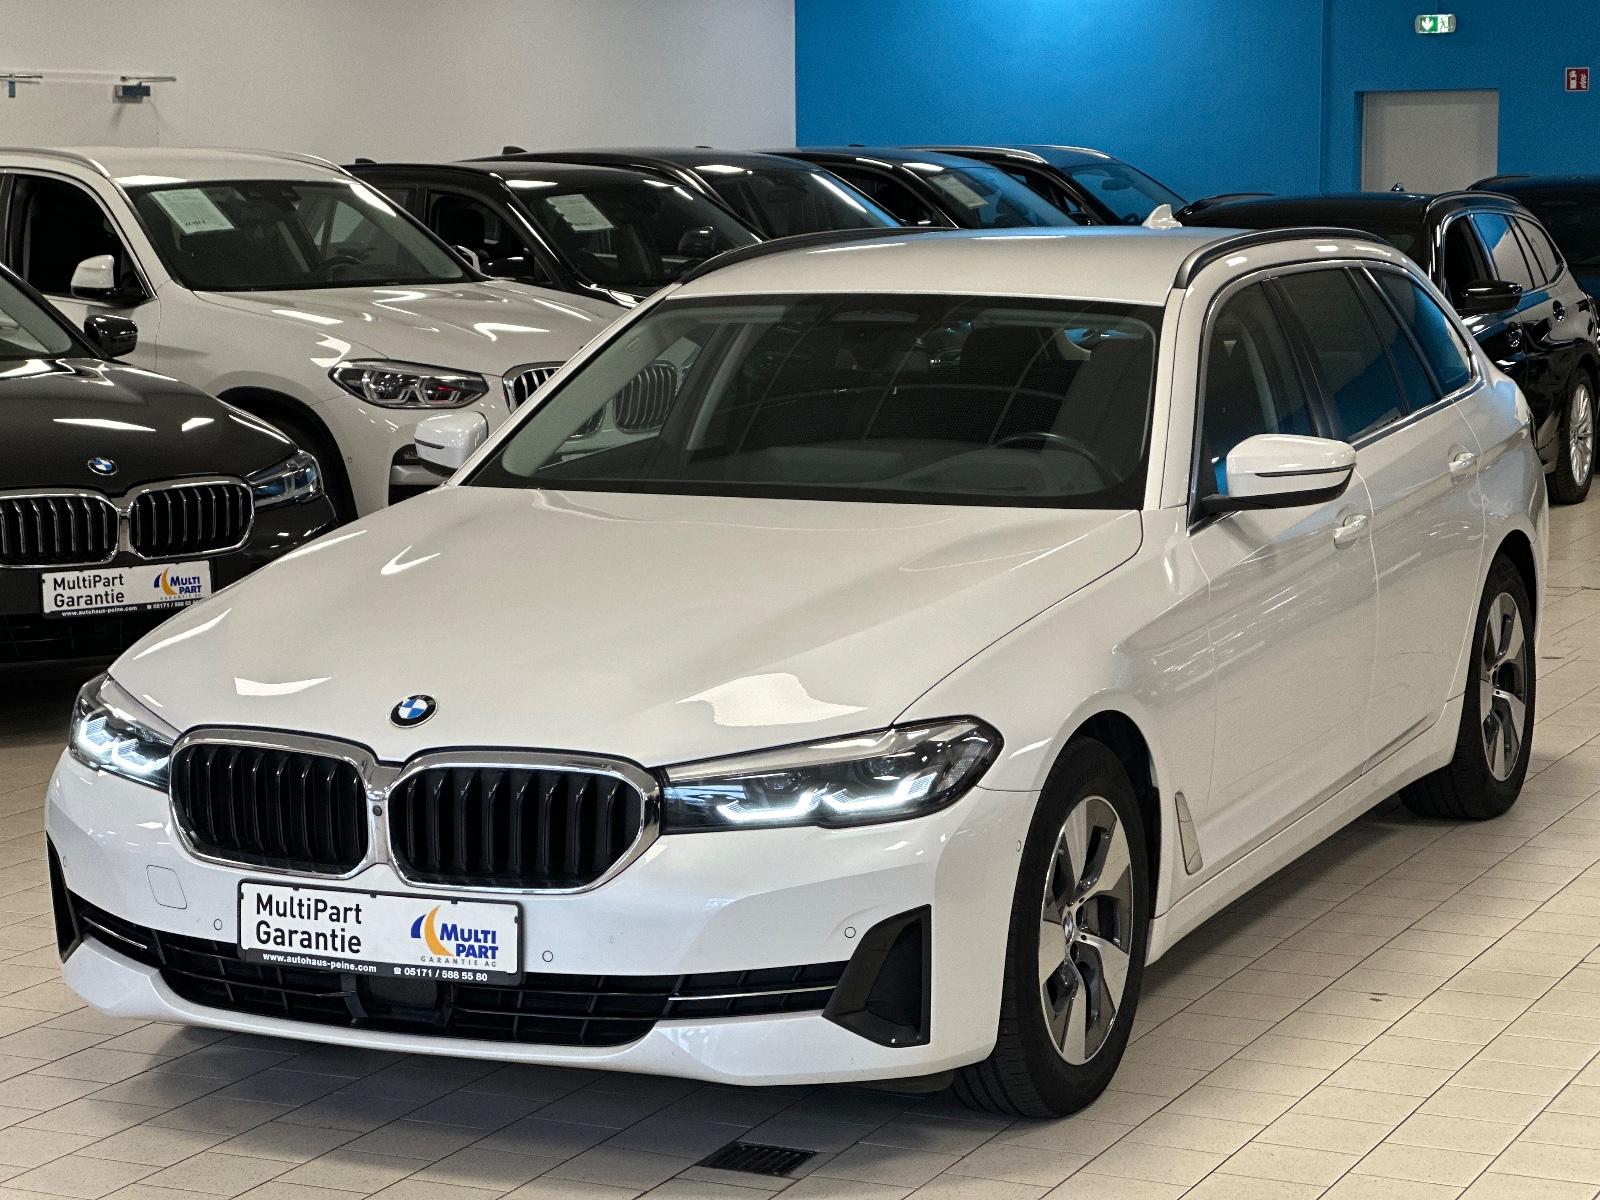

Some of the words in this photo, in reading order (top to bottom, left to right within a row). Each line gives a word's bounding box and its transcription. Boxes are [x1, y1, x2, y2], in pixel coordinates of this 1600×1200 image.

[53, 573, 125, 591] MultiPart
[170, 576, 200, 586] MULTI
[179, 585, 202, 594] PART
[53, 589, 125, 608] Garantie
[61, 606, 138, 617] www.autohaus-peine.com
[256, 892, 362, 924] MultiPart
[255, 920, 362, 954] Garantie
[439, 923, 497, 944] MULTI
[455, 943, 499, 960] PART
[262, 953, 377, 973] www.autohaus-peine.com
[420, 956, 479, 967] GARANTIE
[403, 967, 432, 978] 05171
[441, 970, 460, 980] 588
[461, 972, 474, 980] 55
[475, 973, 488, 982] 80
